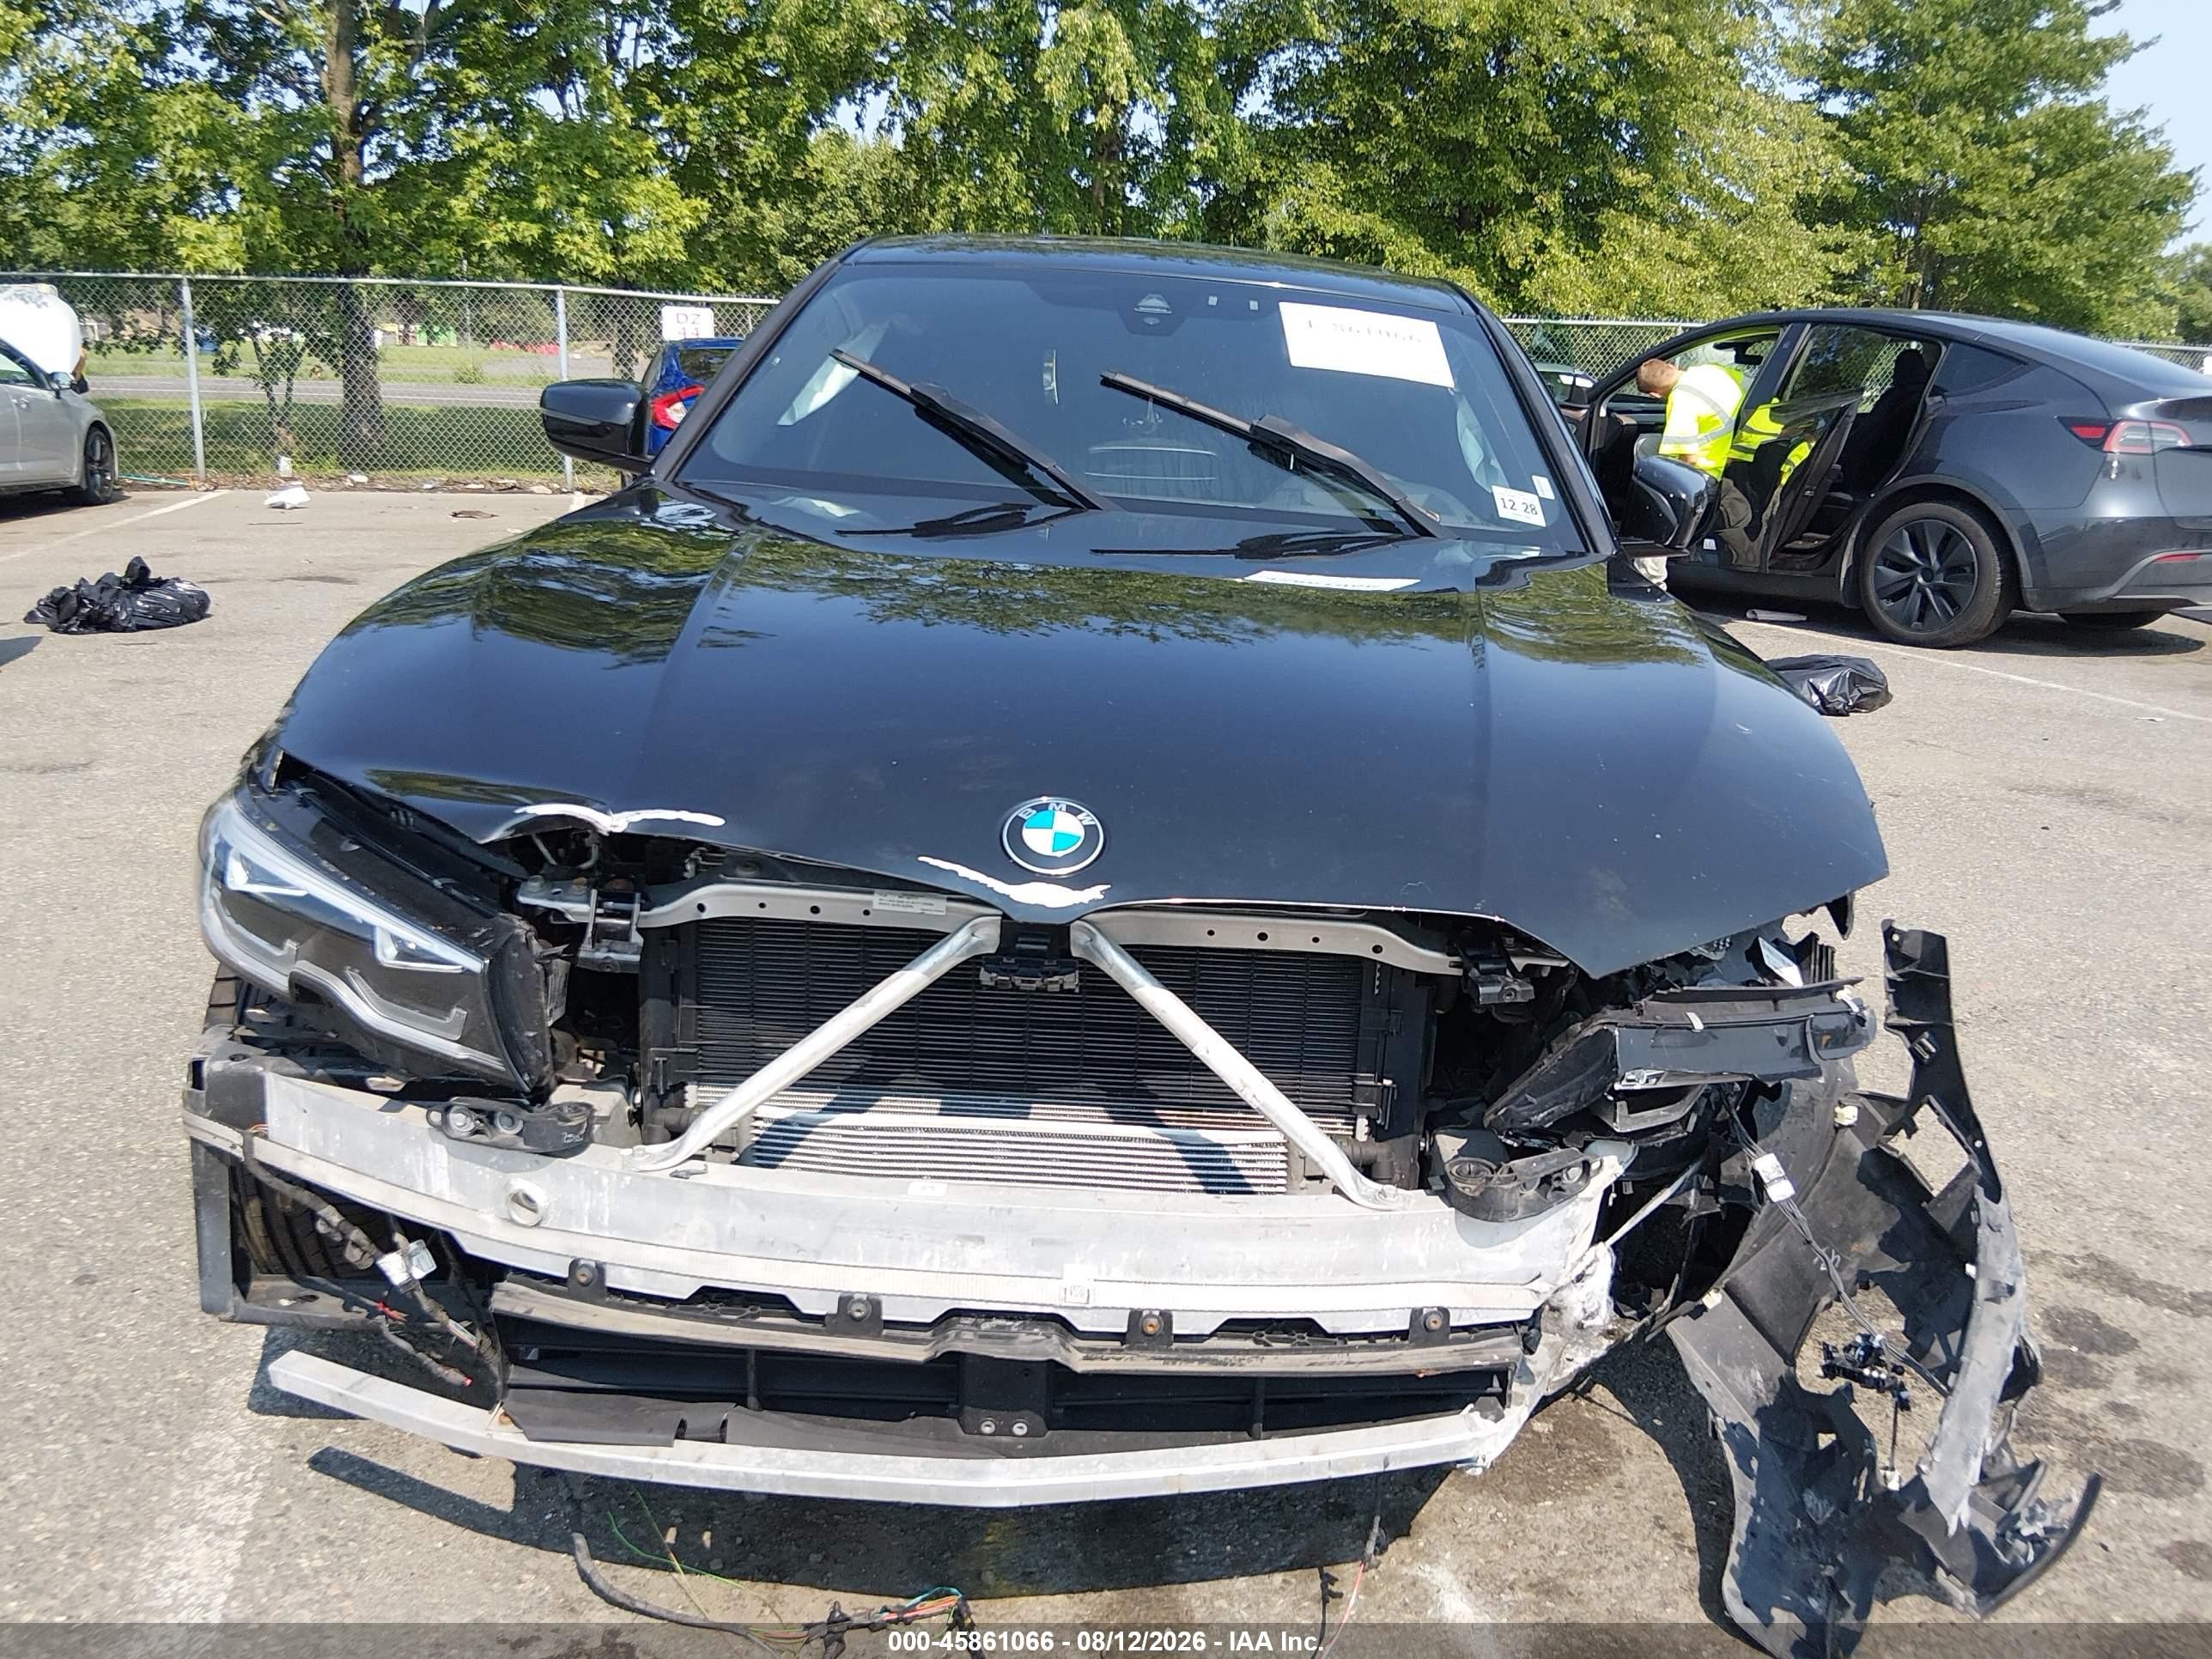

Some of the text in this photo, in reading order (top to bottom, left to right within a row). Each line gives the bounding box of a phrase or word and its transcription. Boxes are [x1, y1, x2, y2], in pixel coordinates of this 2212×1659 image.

[1500, 497, 1538, 516] 12 28
[1018, 802, 1097, 827] BMW
